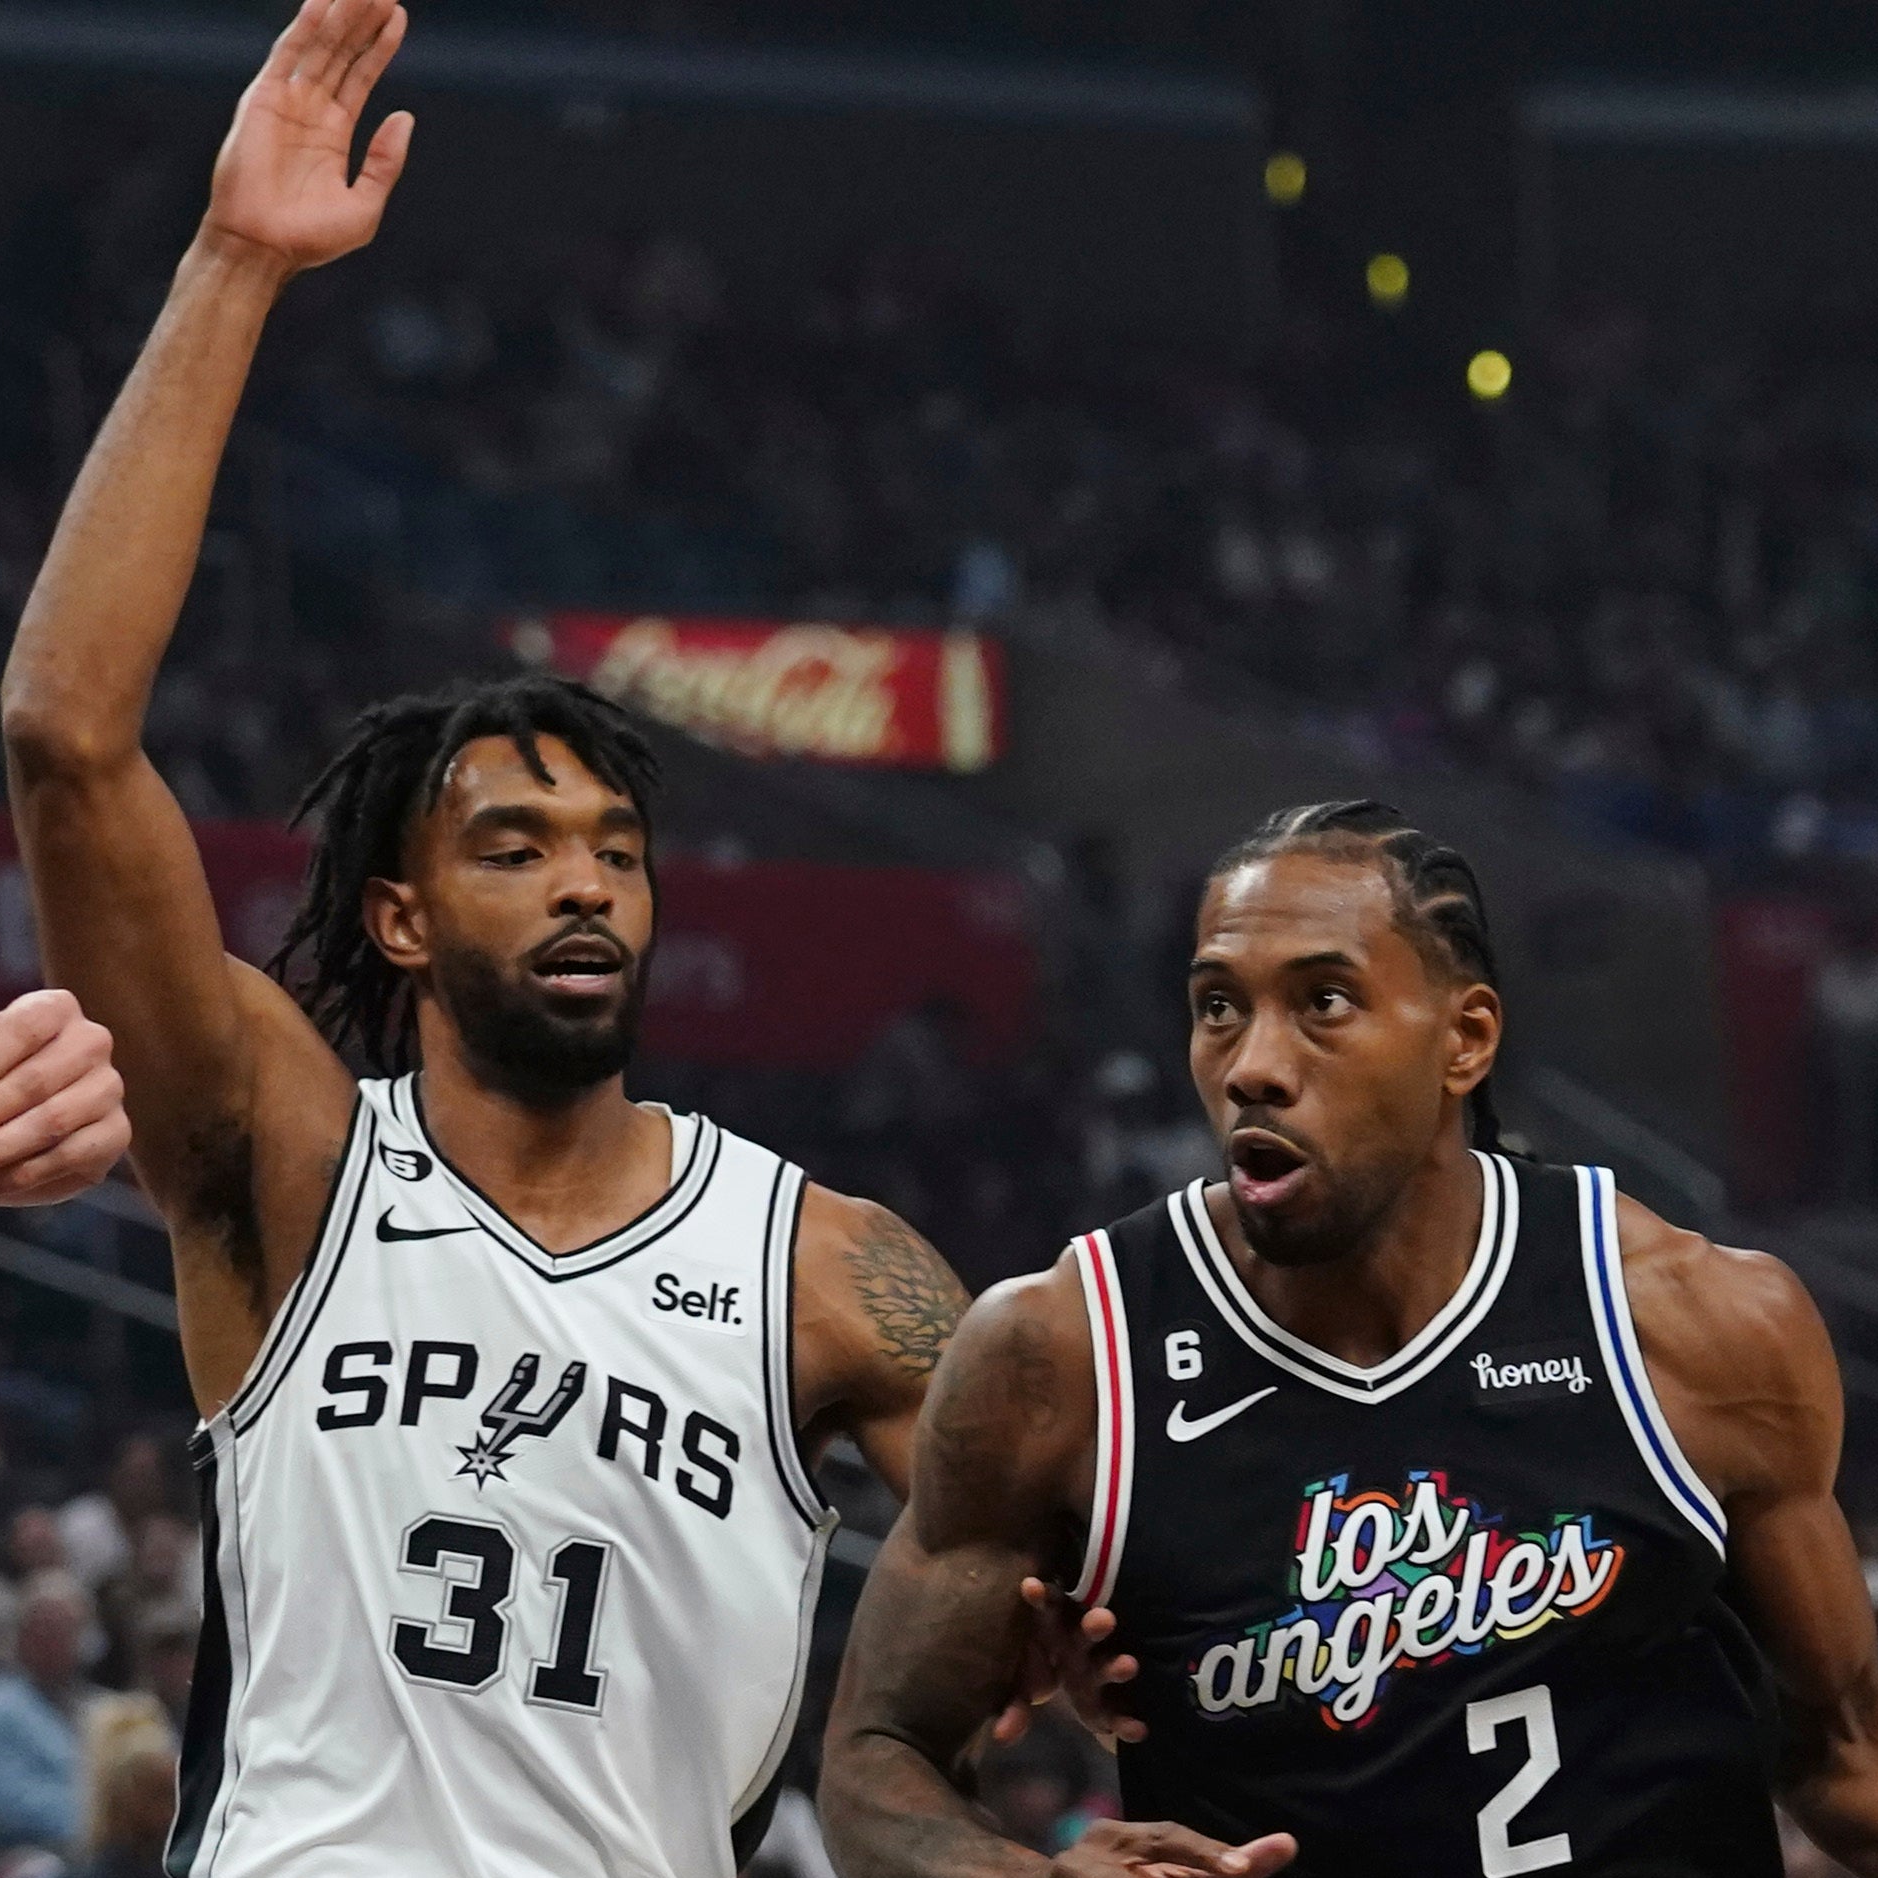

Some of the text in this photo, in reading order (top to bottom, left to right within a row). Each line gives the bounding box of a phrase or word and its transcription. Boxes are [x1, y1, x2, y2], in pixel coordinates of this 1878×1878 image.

[651, 1272, 744, 1326] Self.
[1164, 1330, 1203, 1380] 6
[316, 1340, 742, 1521] SPURS
[1469, 1353, 1593, 1394] honey
[1296, 1479, 1470, 1603] los
[386, 1511, 617, 1717] 31
[1191, 1523, 1616, 1723] angeles
